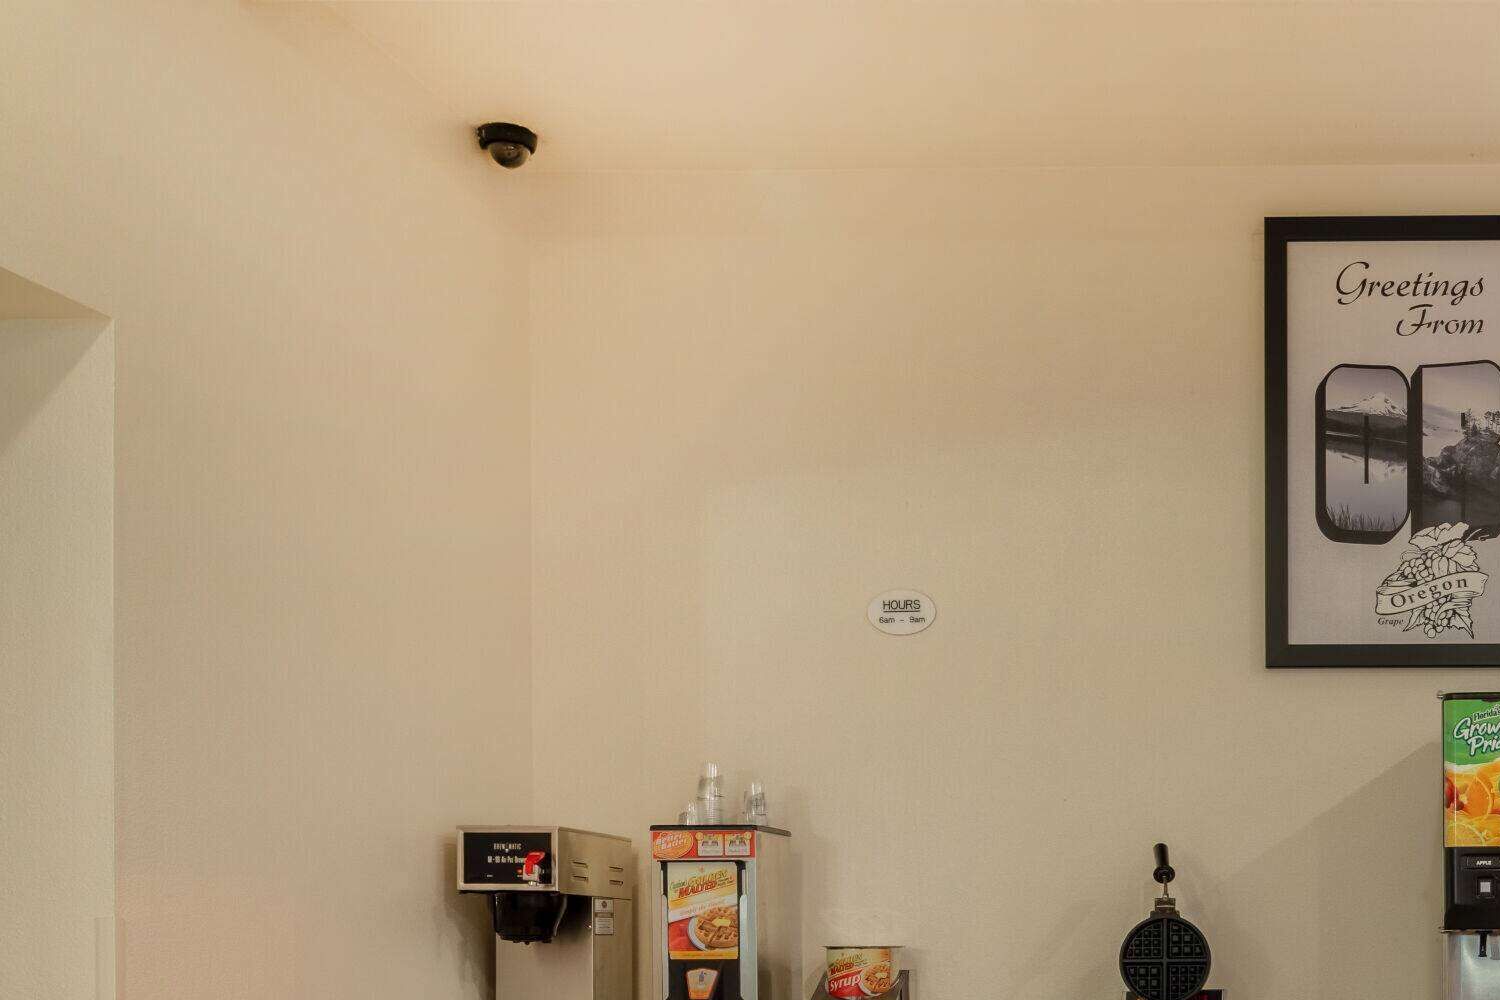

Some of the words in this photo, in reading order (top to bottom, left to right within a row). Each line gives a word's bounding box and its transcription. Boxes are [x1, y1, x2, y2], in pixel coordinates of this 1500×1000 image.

[1336, 261, 1485, 306] Greetings
[1395, 303, 1484, 336] From
[882, 600, 921, 610] HOURS
[1390, 578, 1468, 608] Oregon
[830, 974, 861, 992] Syrup
